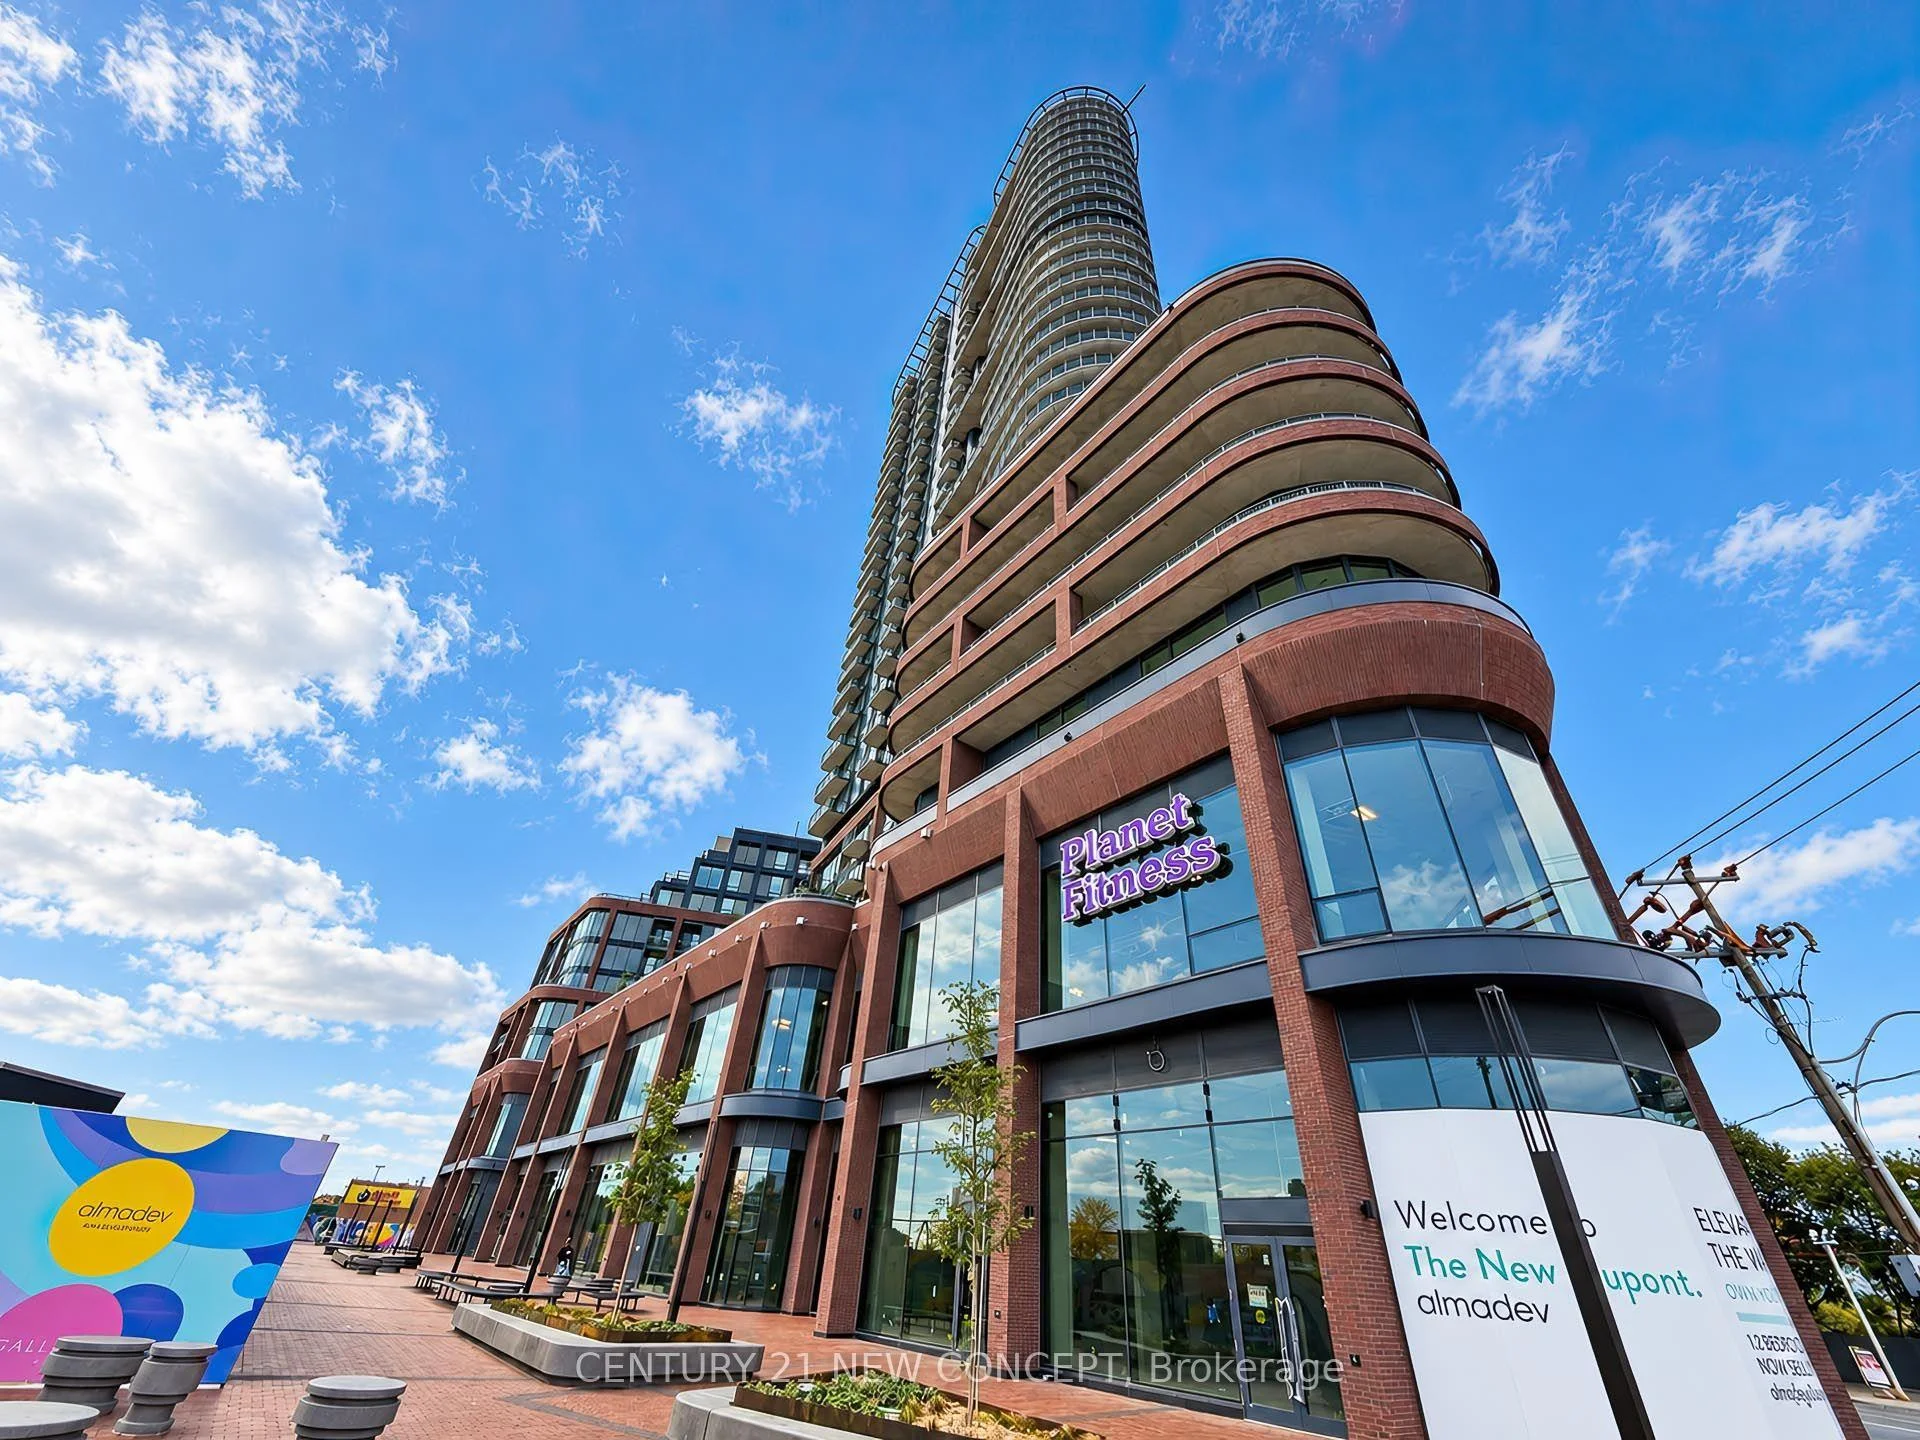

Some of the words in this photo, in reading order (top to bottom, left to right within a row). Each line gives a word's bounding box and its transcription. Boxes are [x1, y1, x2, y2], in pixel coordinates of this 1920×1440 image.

[1059, 793, 1195, 879] Planet
[1062, 836, 1221, 922] Fitness
[78, 1202, 173, 1223] almadev
[1393, 1200, 1548, 1235] Welcome
[1707, 1242, 1748, 1270] THE
[1403, 1245, 1467, 1279] The
[1475, 1247, 1555, 1285] New
[1601, 1268, 1703, 1305] upont.
[1417, 1289, 1549, 1323] almadev
